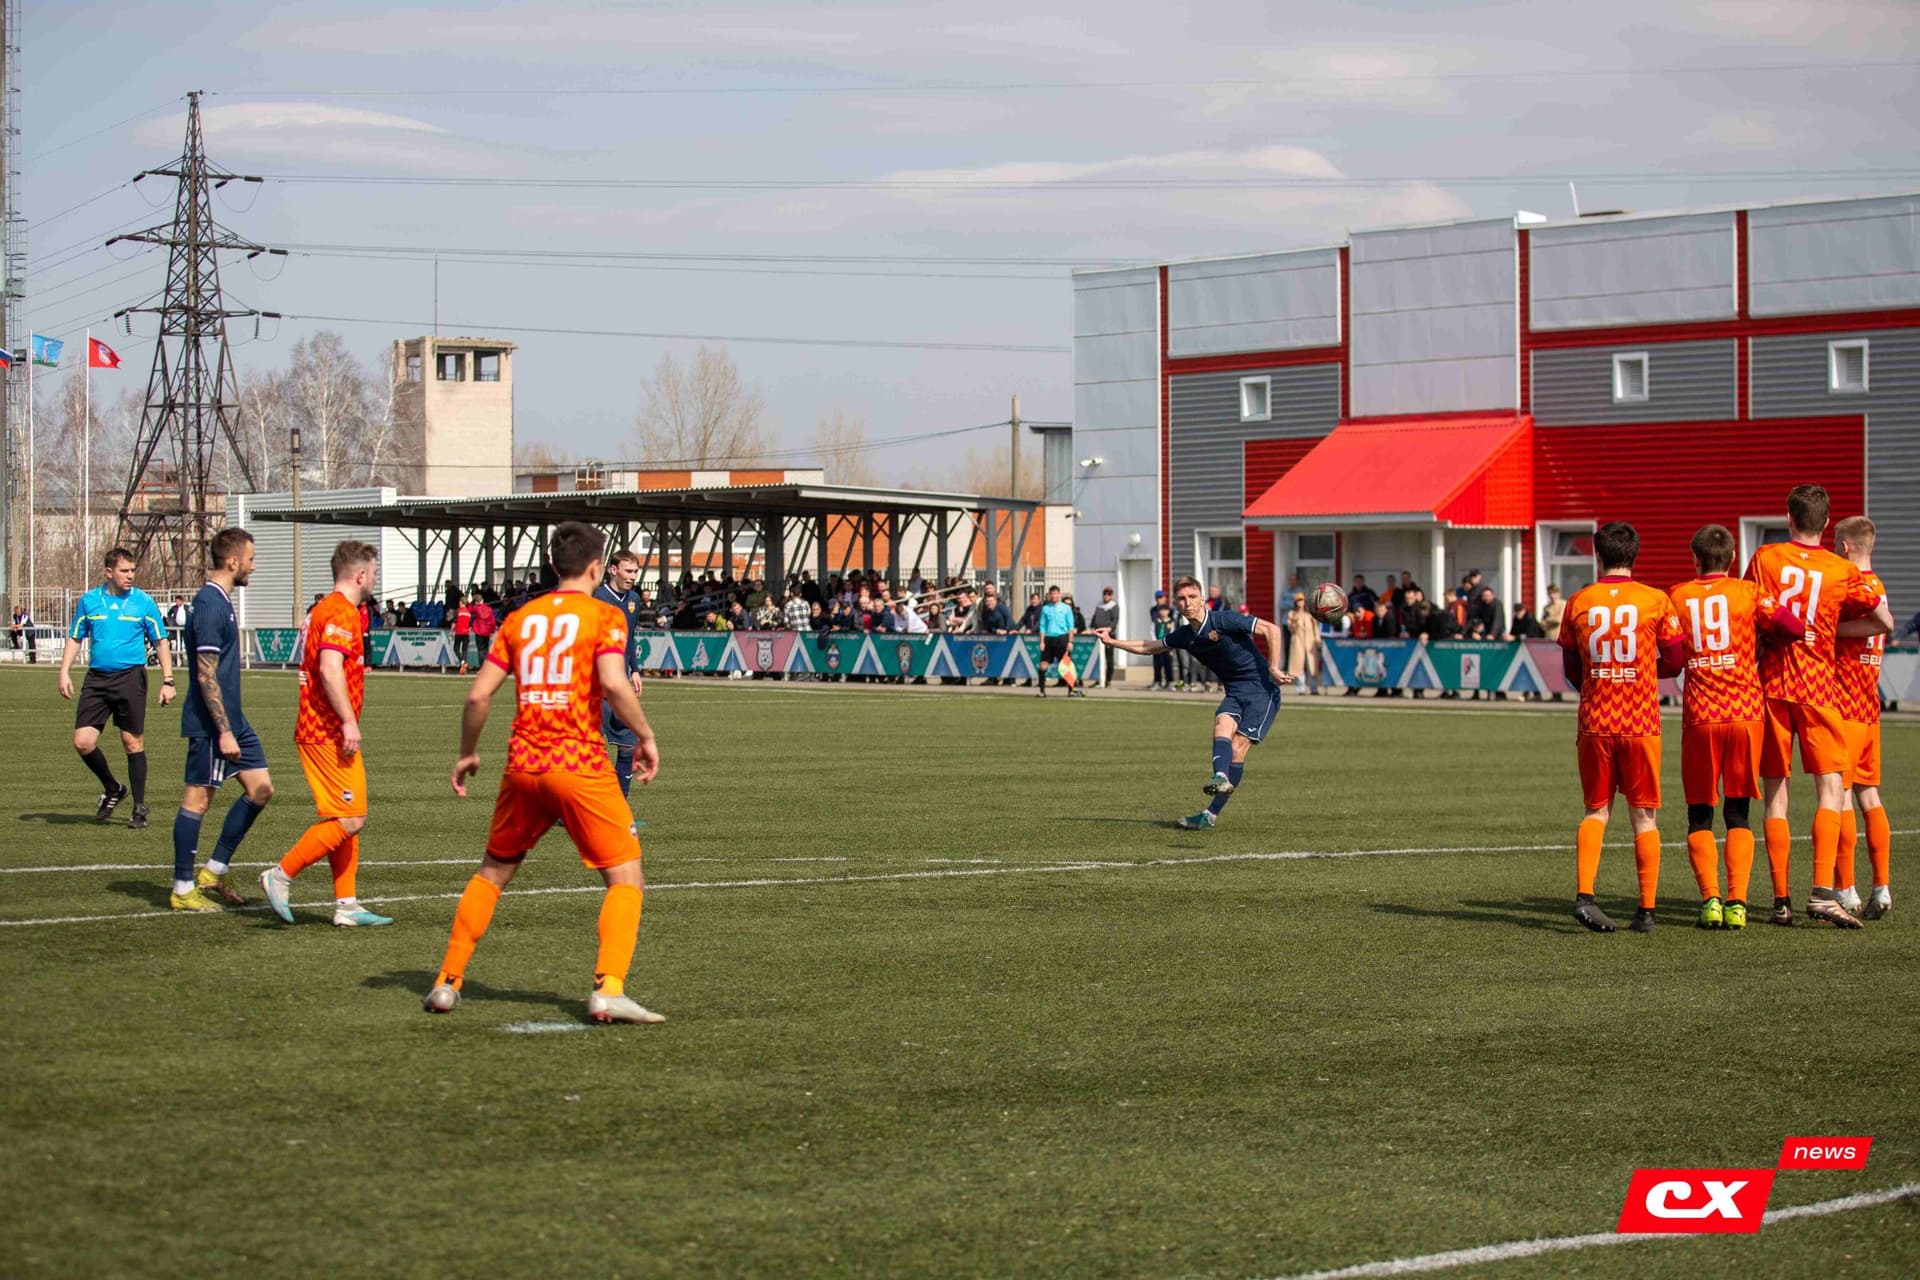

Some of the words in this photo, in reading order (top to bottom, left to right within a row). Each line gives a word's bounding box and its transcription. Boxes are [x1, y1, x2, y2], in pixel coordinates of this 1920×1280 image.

[1685, 594, 1730, 653] 19
[1779, 565, 1823, 626] 21
[520, 613, 580, 685] 22
[1588, 604, 1638, 663] 23
[1687, 654, 1735, 669] SEUS
[520, 690, 569, 704] SEUS
[1590, 667, 1636, 679] SEUS
